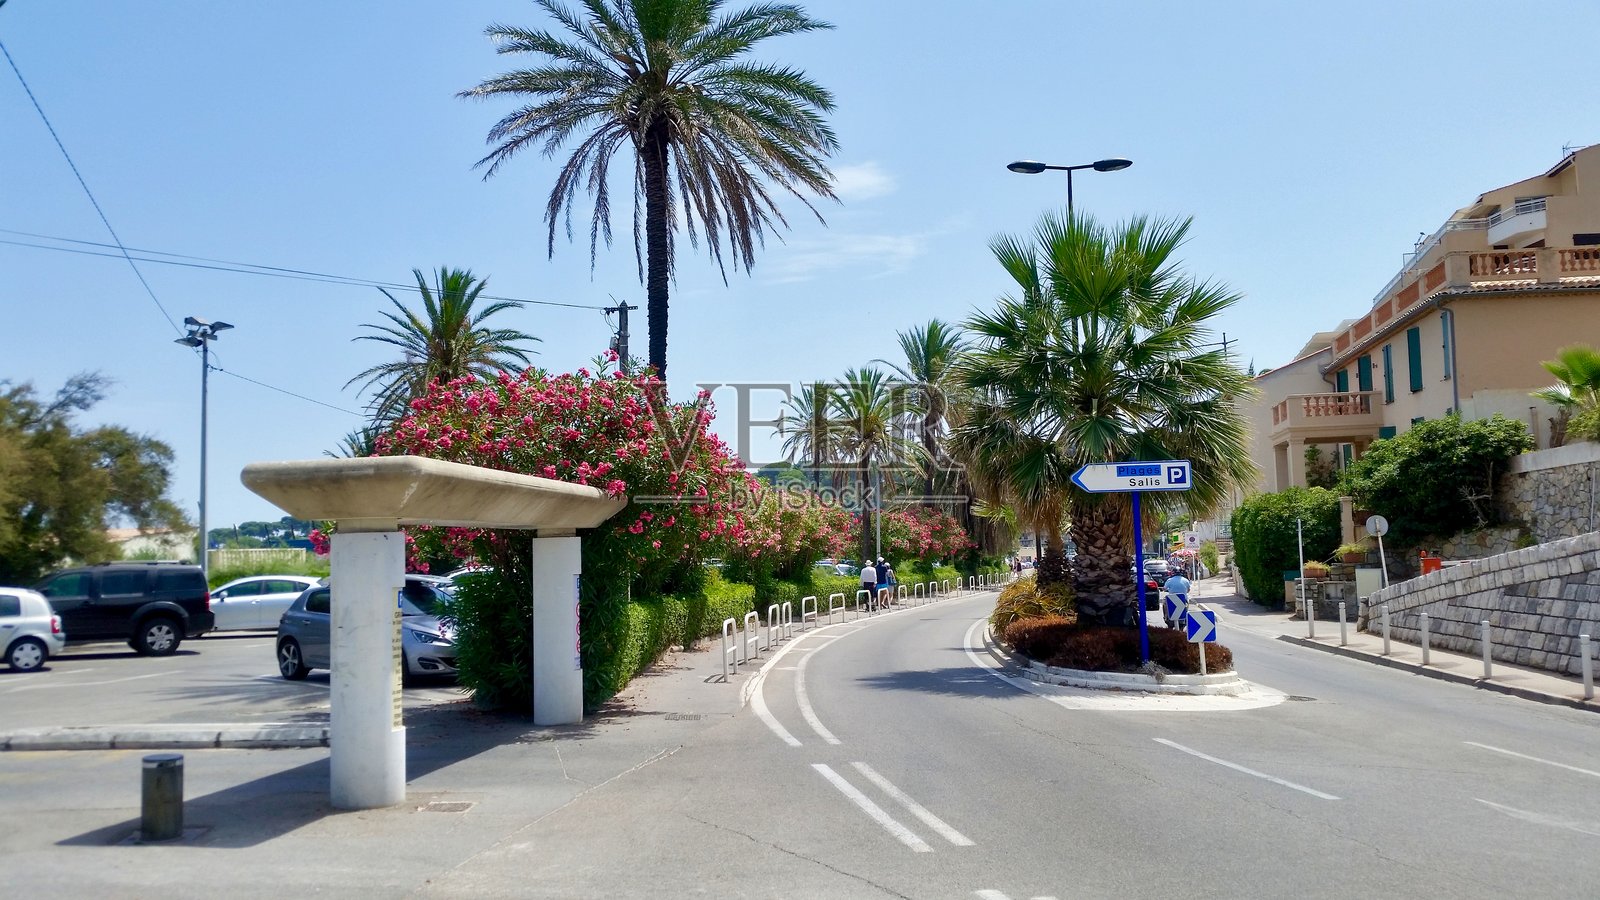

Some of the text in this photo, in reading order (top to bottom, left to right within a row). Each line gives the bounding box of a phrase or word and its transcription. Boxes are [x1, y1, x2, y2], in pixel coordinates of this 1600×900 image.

[1118, 466, 1161, 476] Plages
[1170, 468, 1183, 483] P
[1129, 478, 1161, 487] Salis
